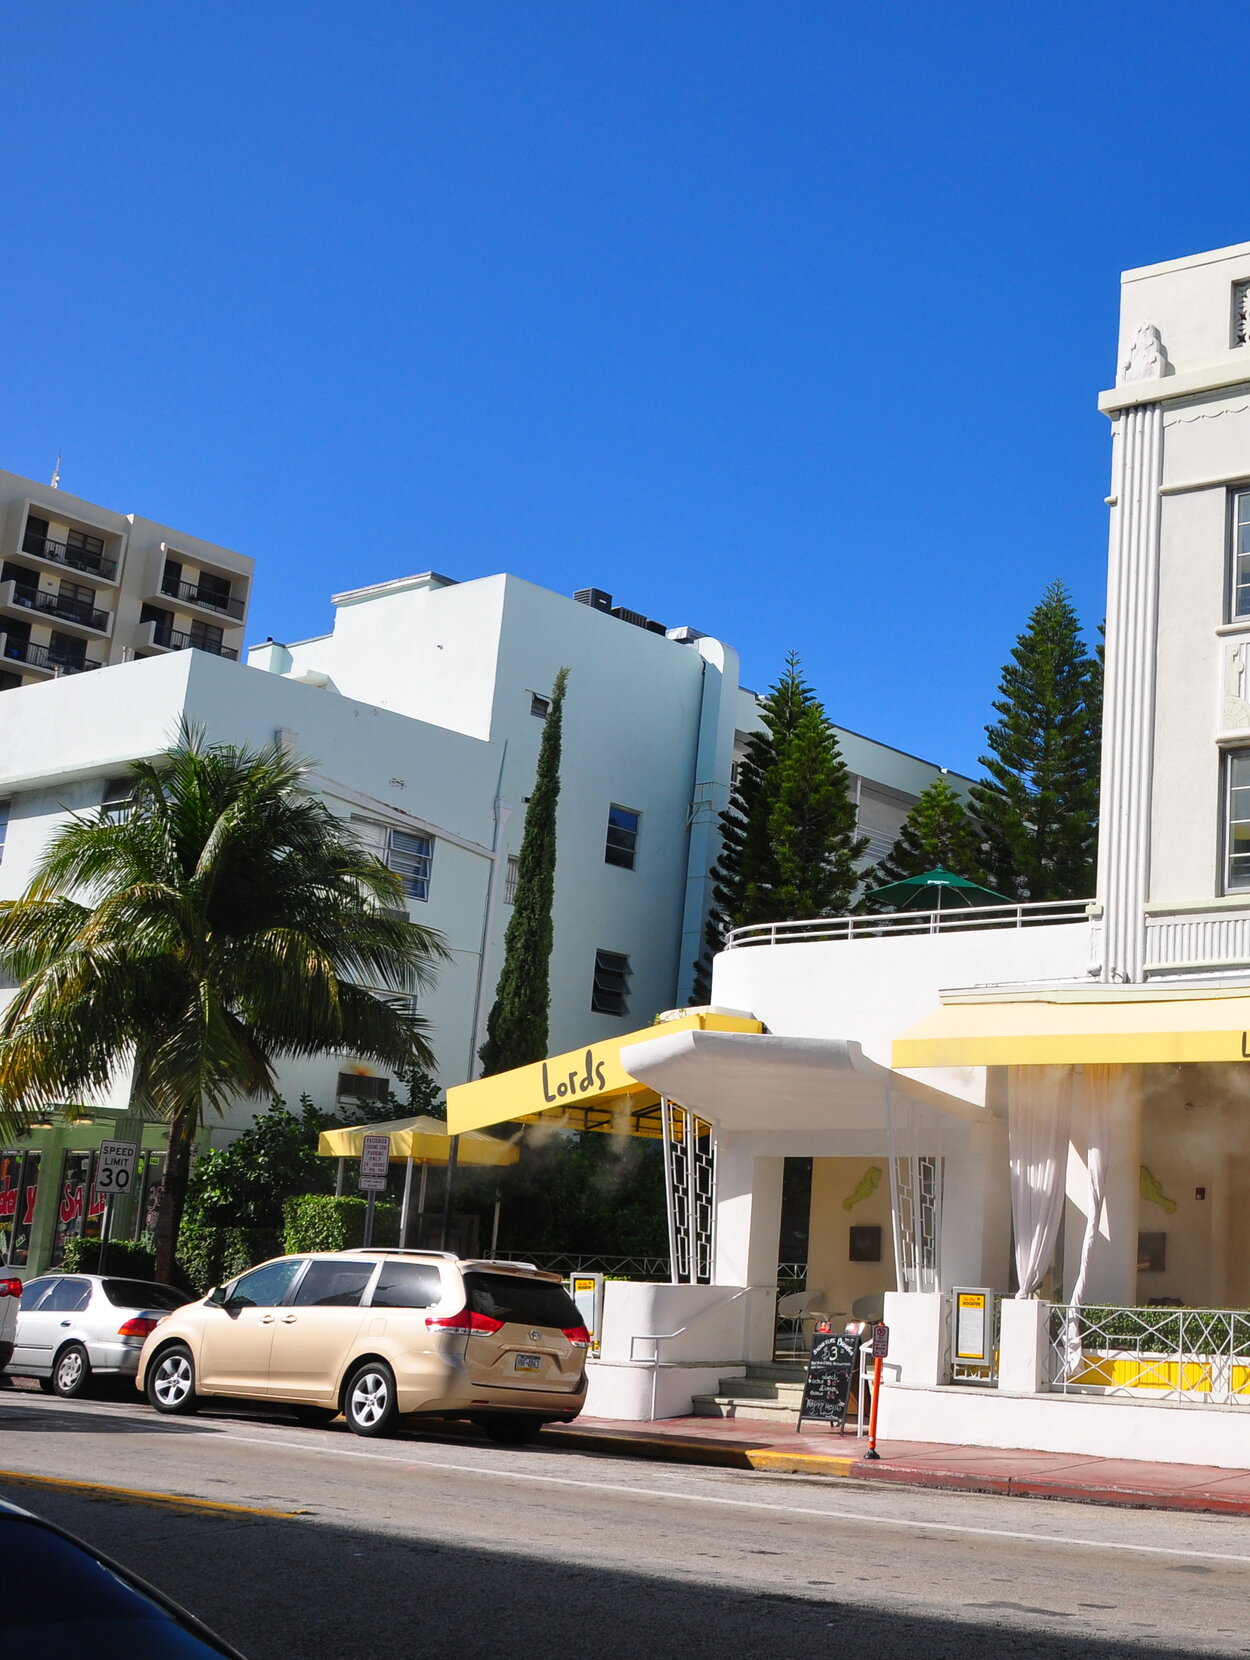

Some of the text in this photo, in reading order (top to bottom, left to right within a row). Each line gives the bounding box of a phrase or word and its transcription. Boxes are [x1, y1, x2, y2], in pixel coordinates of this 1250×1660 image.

[542, 1049, 605, 1102] Lords
[103, 1146, 134, 1156] SPEED
[104, 1157, 129, 1167] LIMIT
[99, 1167, 130, 1188] 30
